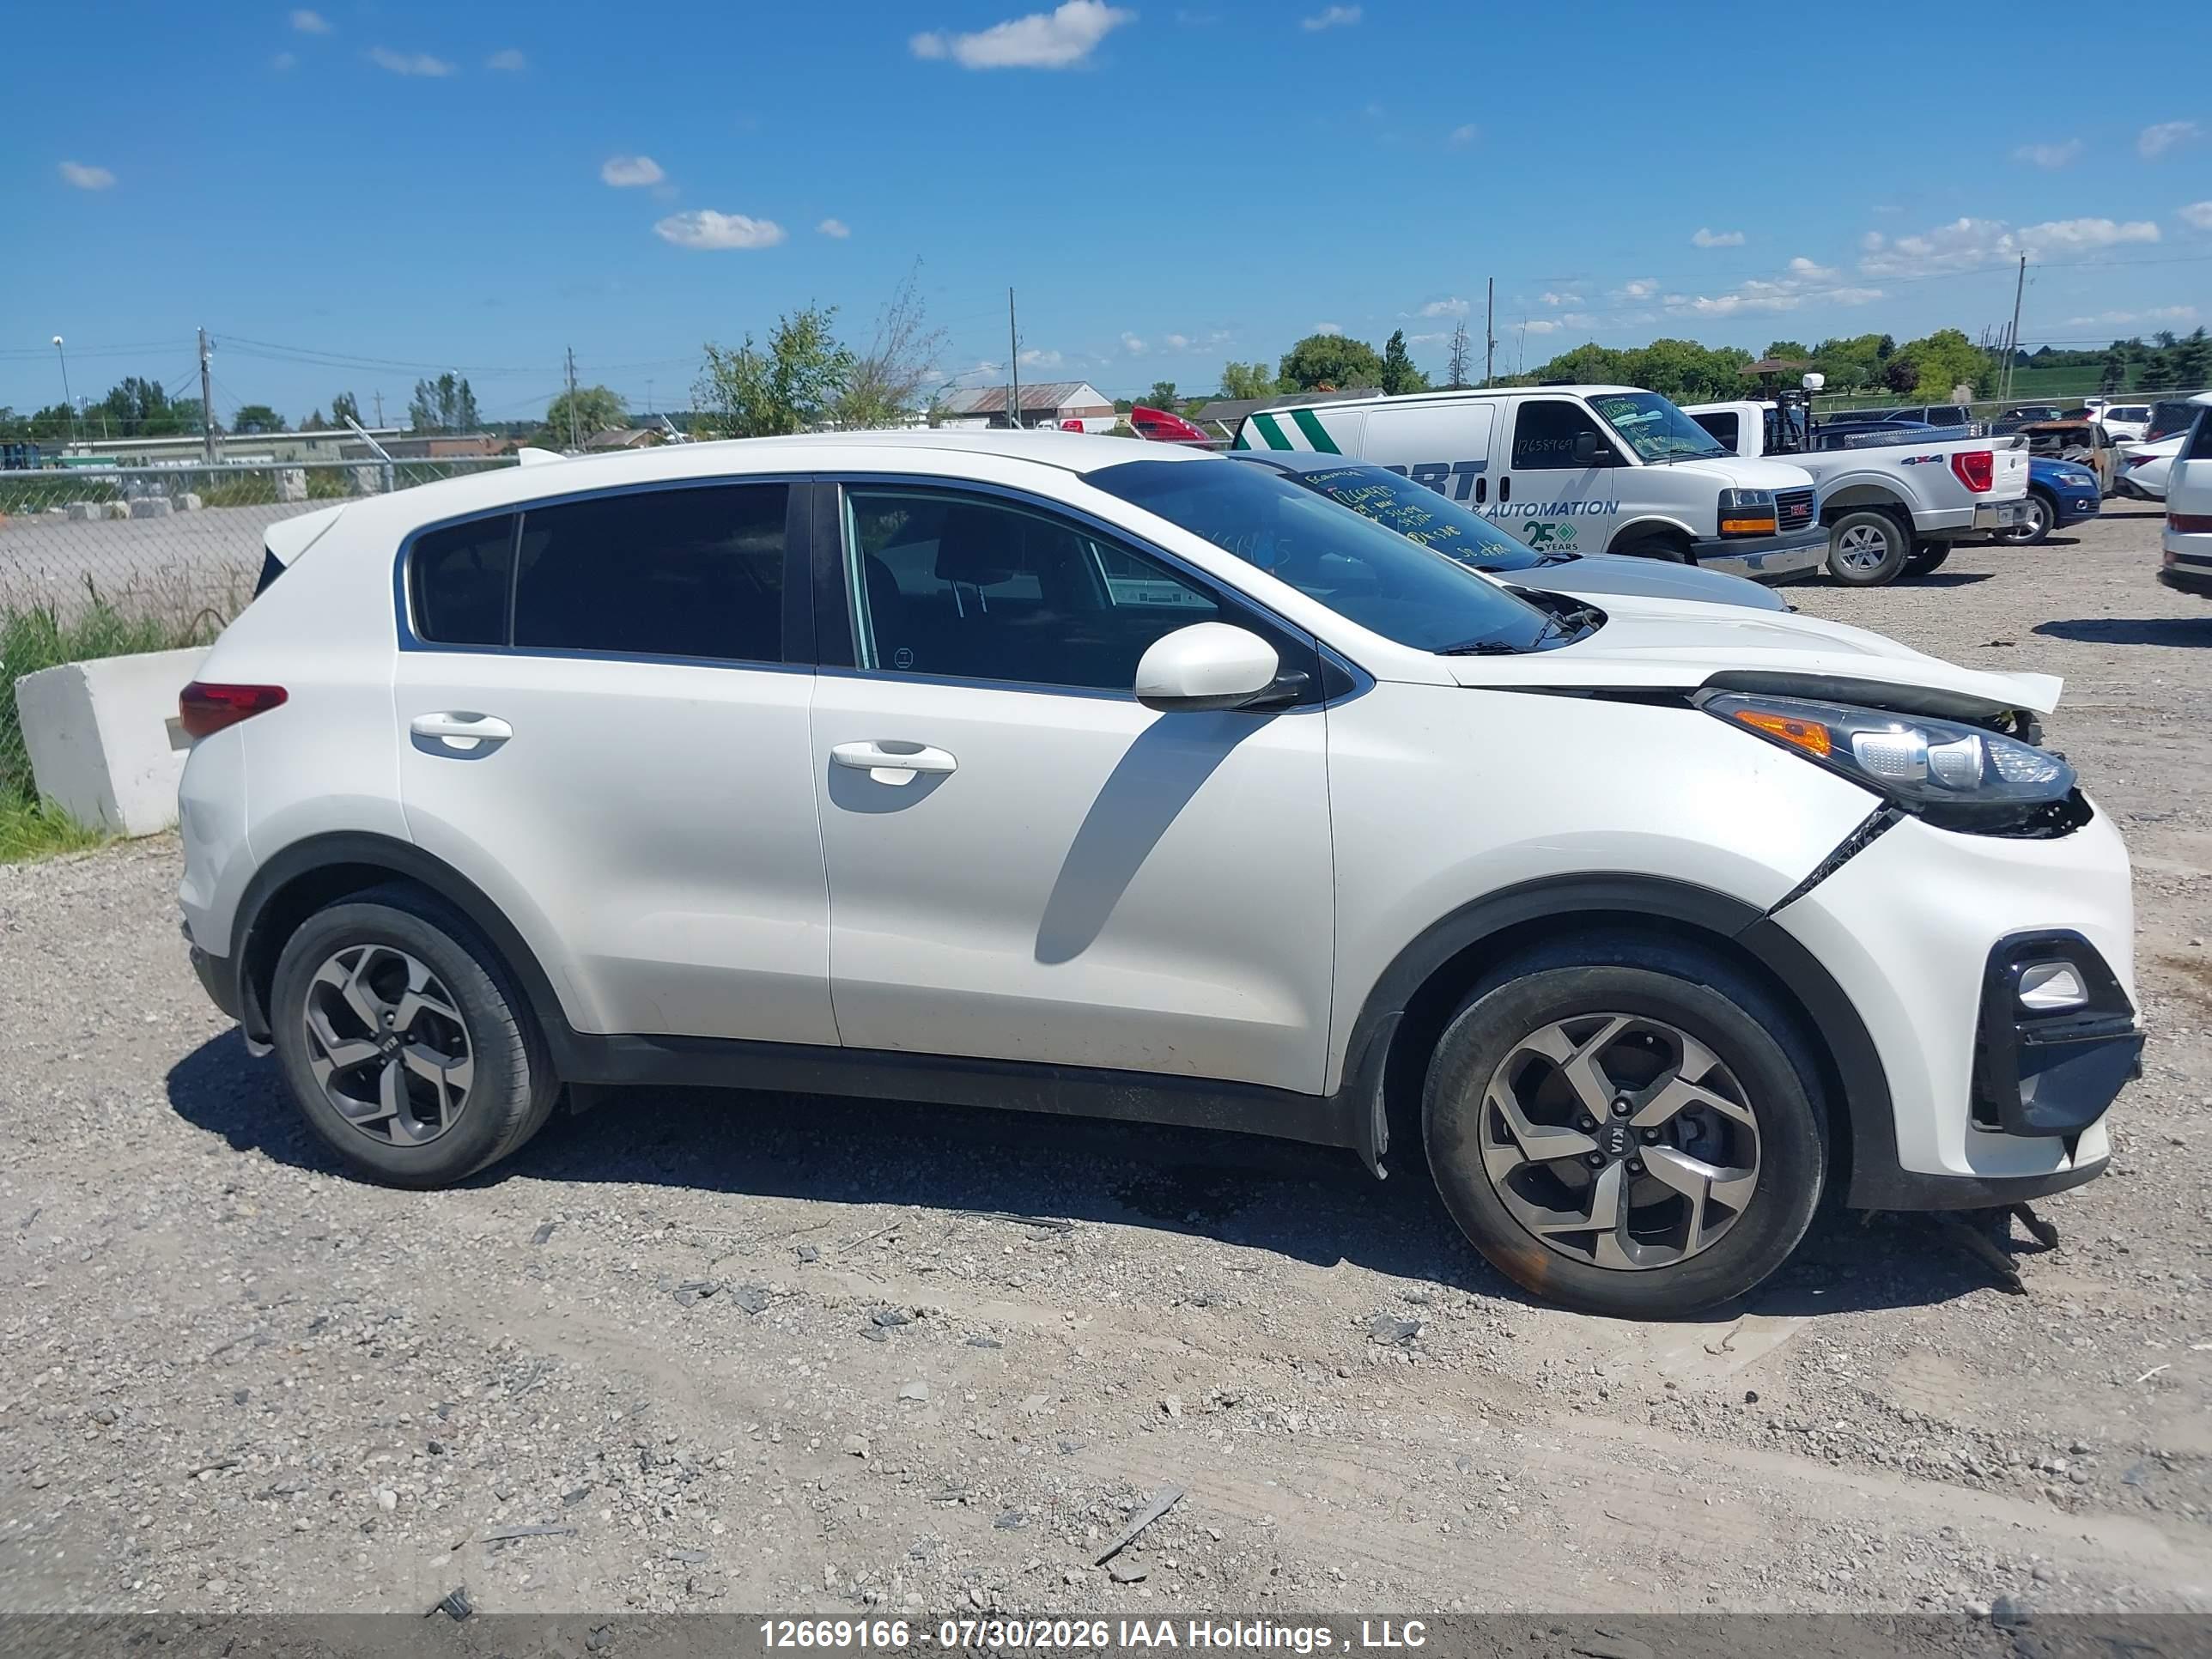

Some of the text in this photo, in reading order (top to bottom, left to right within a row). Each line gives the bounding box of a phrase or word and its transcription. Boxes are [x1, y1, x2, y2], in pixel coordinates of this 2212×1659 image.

[1485, 500, 1621, 519] AUTOMATION
[1522, 520, 1556, 552] 25
[1545, 543, 1579, 551] YEARS
[1611, 1127, 1625, 1153] KIA
